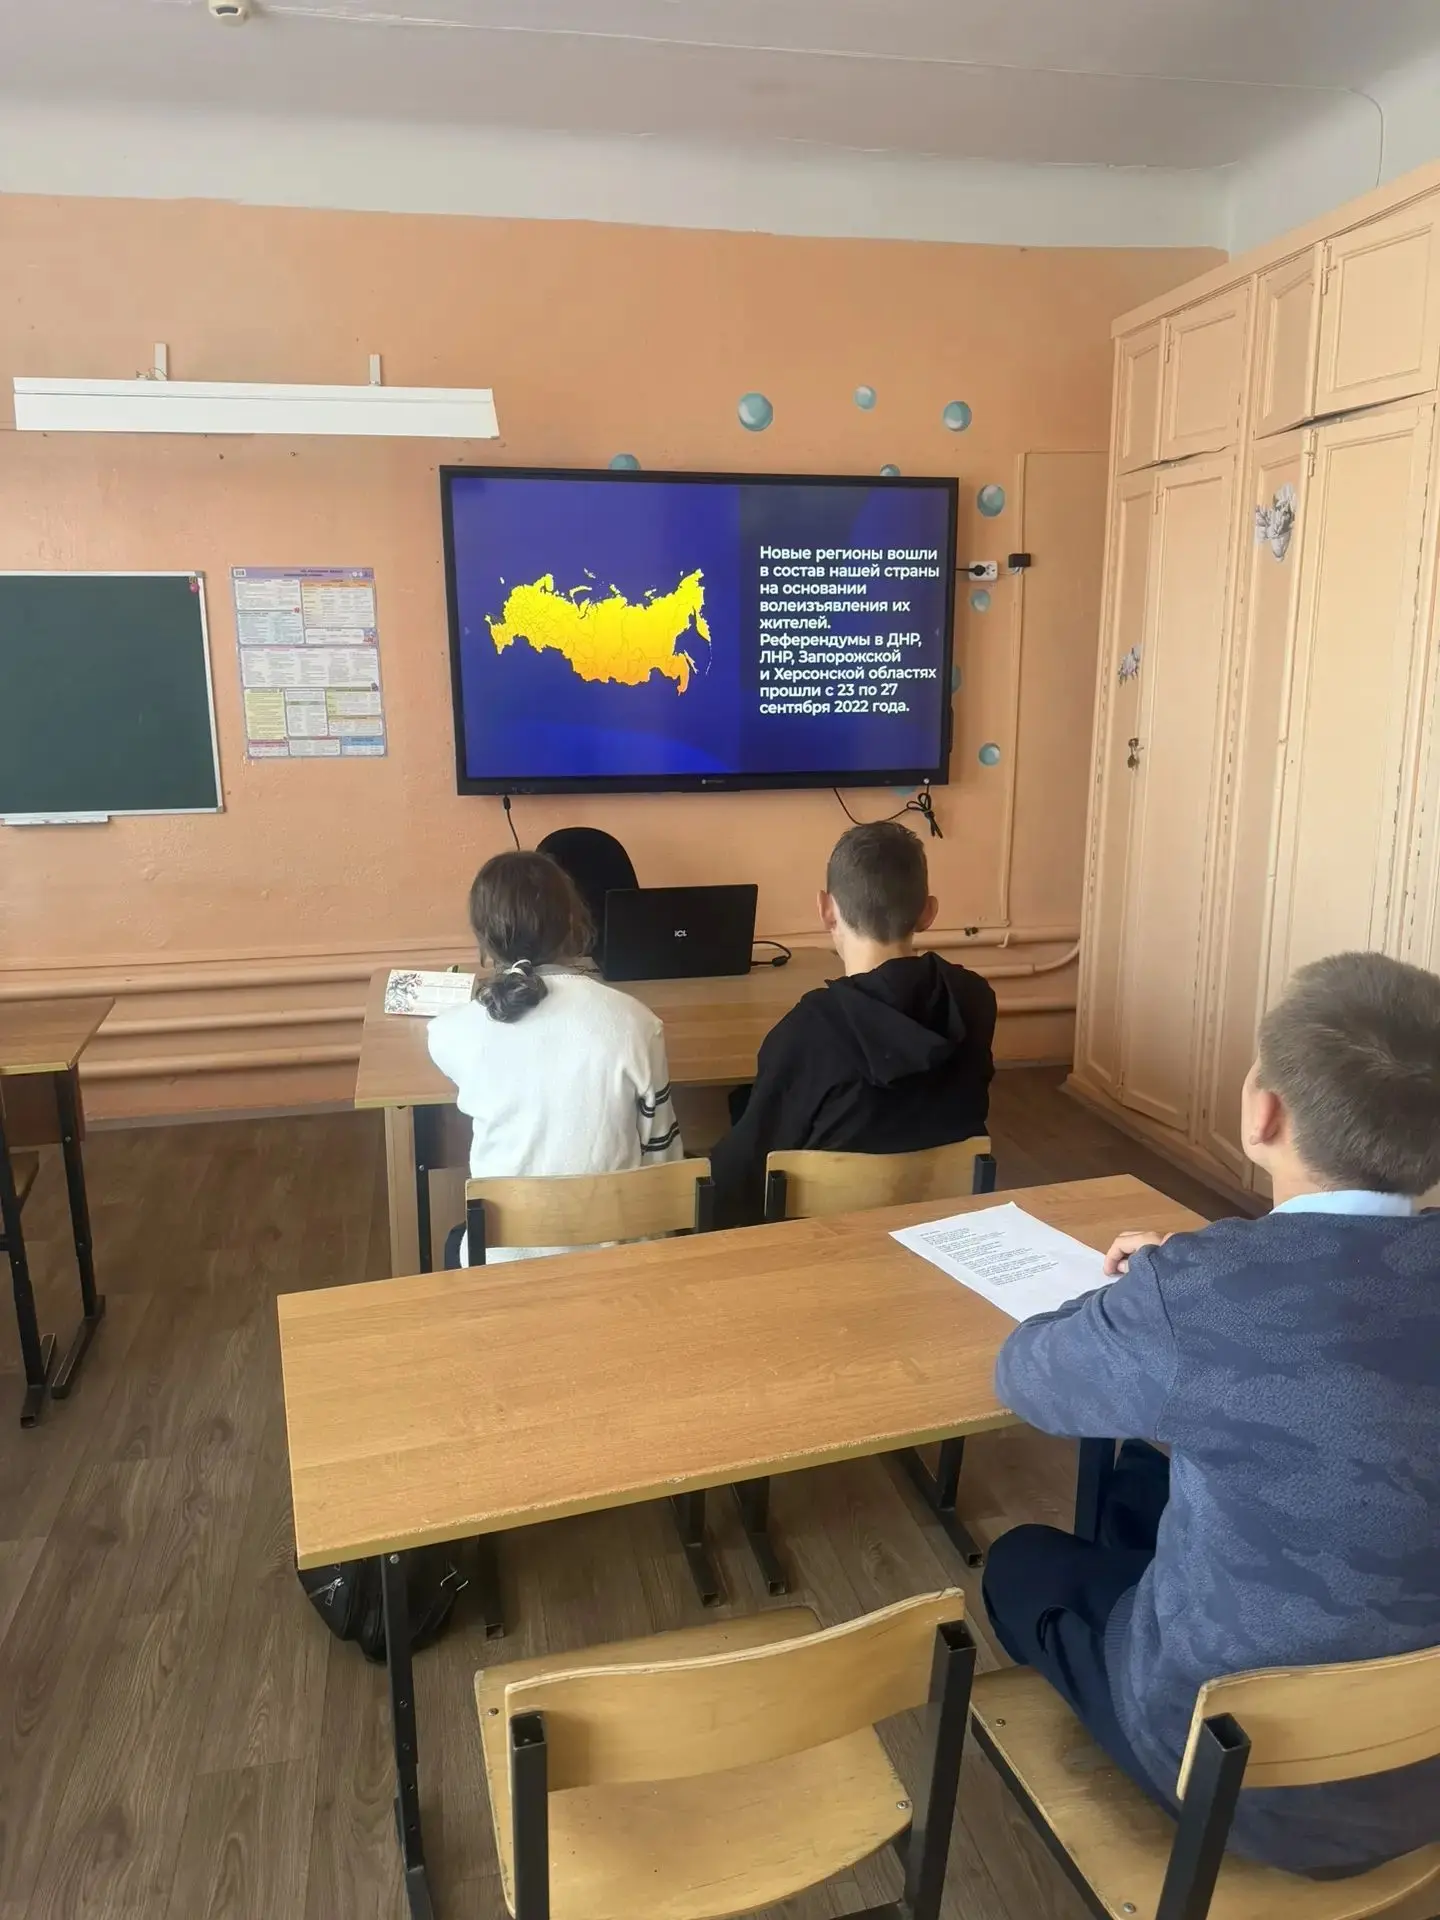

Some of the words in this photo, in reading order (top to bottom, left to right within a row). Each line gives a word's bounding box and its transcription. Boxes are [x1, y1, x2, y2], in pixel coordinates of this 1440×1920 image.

[760, 546, 811, 559] Новые
[816, 549, 882, 562] регионы
[888, 549, 937, 560] вошли
[760, 567, 768, 577] в
[773, 567, 825, 577] состав
[830, 564, 879, 577] нашей
[884, 567, 939, 579] страны
[760, 584, 778, 594] на
[783, 584, 866, 594] основании
[760, 602, 888, 611] волеизъявления
[893, 601, 910, 611] их
[760, 616, 830, 629] жителей.
[760, 634, 870, 648] Референдумы
[875, 635, 883, 645] в
[887, 633, 922, 648] ДНР,
[760, 651, 795, 665] ЛНР,
[799, 649, 901, 665] Запорожской
[760, 670, 769, 680] и
[774, 667, 864, 682] Херсонской
[869, 666, 936, 679] областях
[760, 686, 820, 699] прошли
[825, 686, 833, 696] с
[837, 684, 854, 696] 23
[859, 686, 877, 696] по
[881, 683, 898, 695] 27
[760, 701, 830, 715] сентября
[835, 701, 868, 713] 2022
[873, 702, 909, 713] года.
